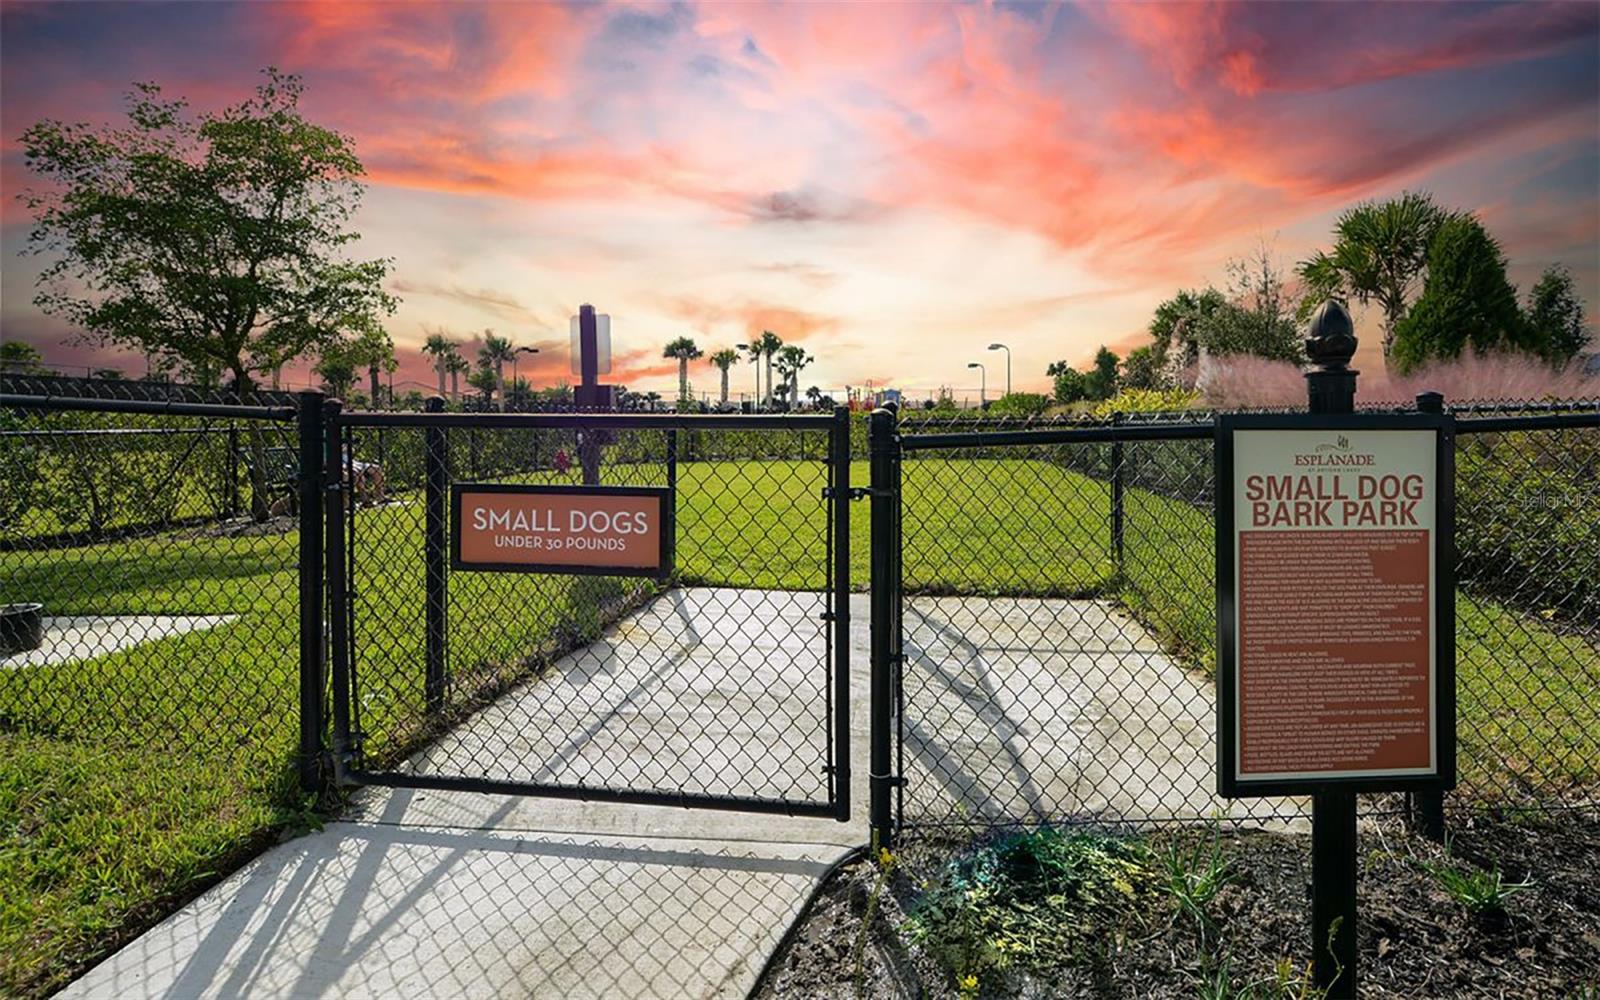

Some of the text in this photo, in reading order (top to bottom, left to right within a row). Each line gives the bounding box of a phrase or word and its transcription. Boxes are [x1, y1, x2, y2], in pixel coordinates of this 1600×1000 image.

[1294, 454, 1375, 466] ESPLANADE
[1246, 474, 1424, 501] SMALL DOG
[473, 507, 648, 534] SMALL DOGS
[1252, 501, 1419, 527] BARK PARK
[495, 535, 626, 551] UNDER 30 POUNDS
